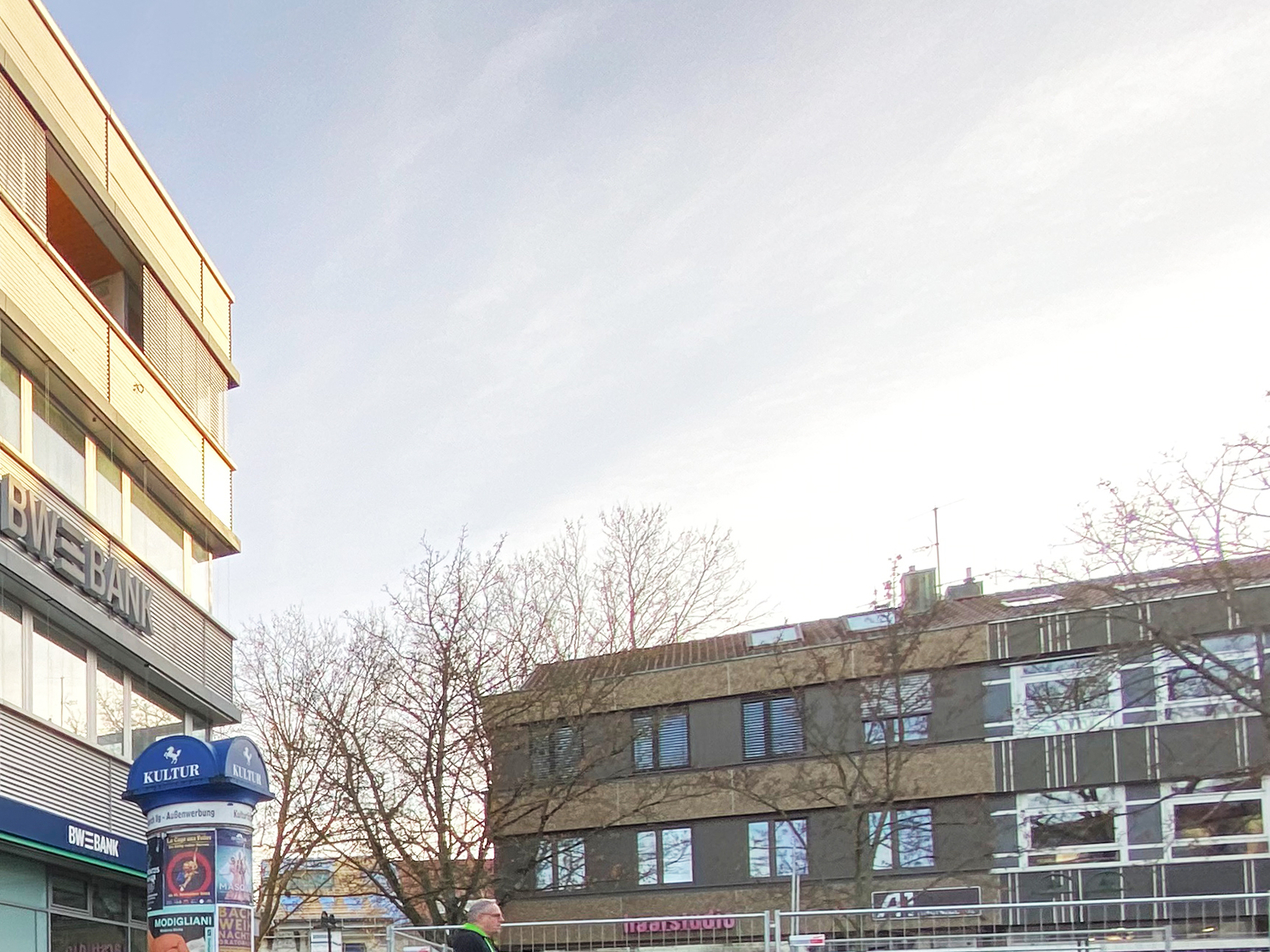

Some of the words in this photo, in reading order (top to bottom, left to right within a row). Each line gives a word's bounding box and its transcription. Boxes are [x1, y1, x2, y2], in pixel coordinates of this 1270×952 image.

[143, 763, 200, 785] KULTUR
[232, 763, 262, 786] KULTUR
[166, 809, 215, 820] Außenwerbung
[154, 916, 212, 928] MODIGLIANI
